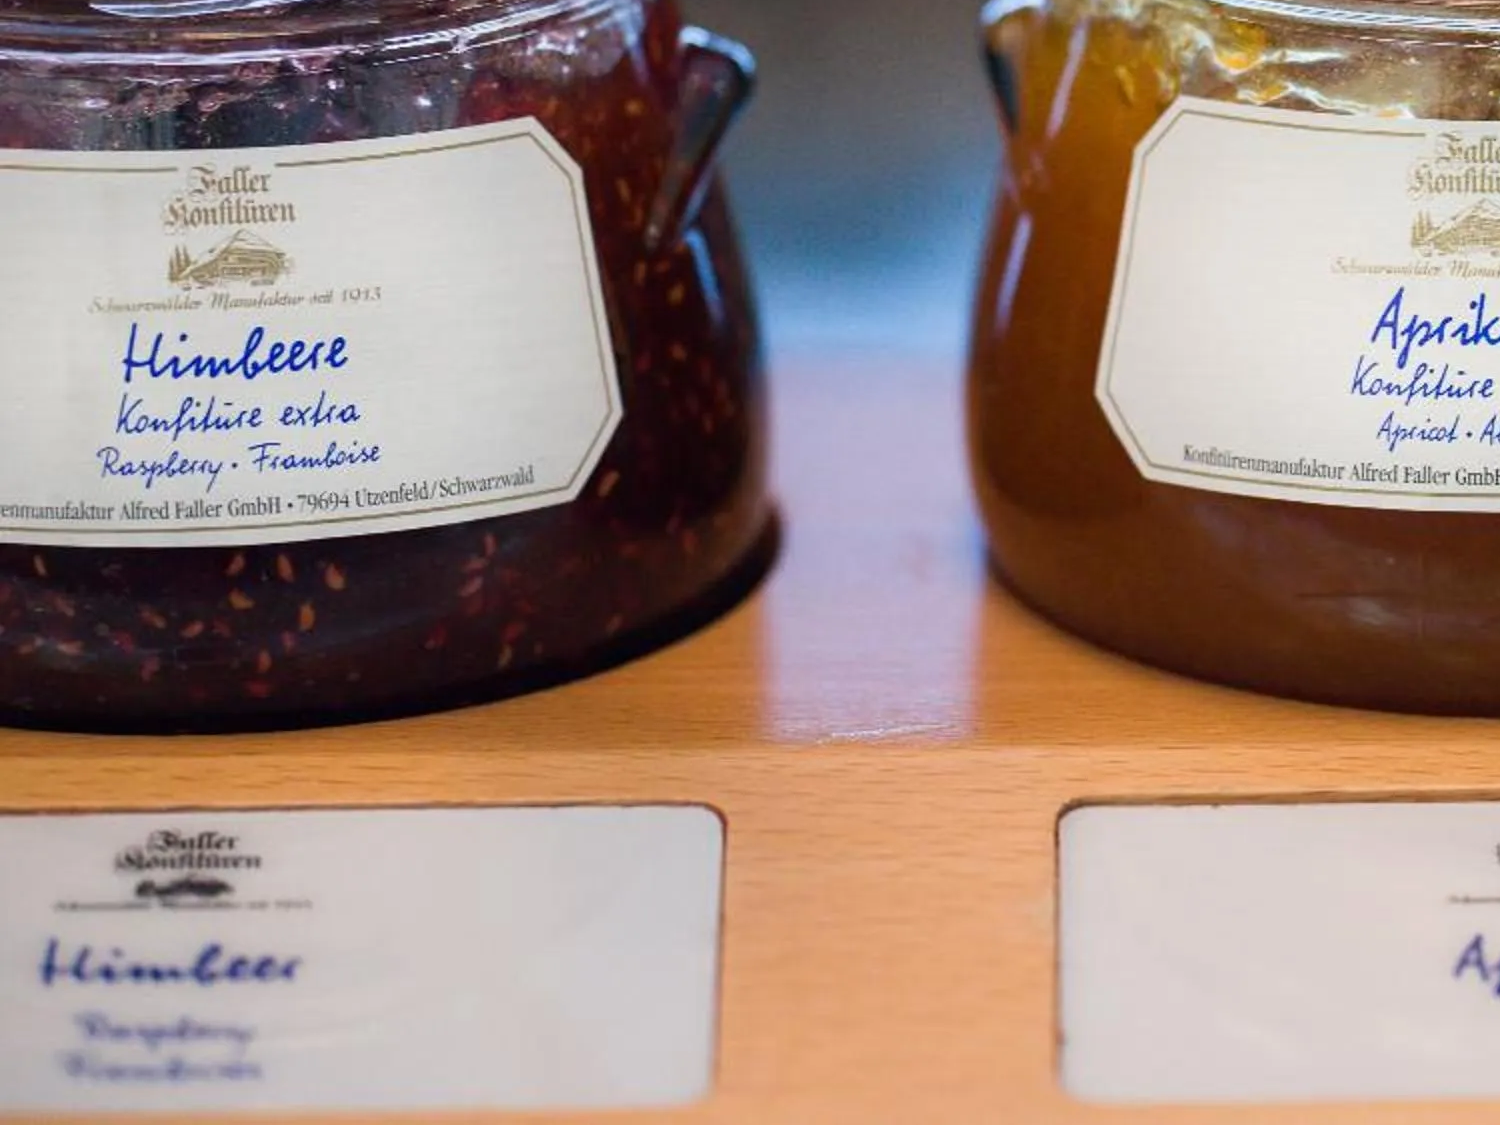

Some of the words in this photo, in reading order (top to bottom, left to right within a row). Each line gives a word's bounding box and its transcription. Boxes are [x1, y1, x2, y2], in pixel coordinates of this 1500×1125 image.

[189, 163, 272, 200] Faller
[162, 194, 297, 234] Konfitüren
[88, 295, 201, 314] Schwarzwälder
[209, 291, 304, 311] Manufaktur
[310, 289, 334, 305] seit
[341, 287, 382, 303] 1913
[122, 322, 349, 383] Himbeere
[1350, 354, 1494, 407] Konfitüre
[116, 392, 262, 442] Konfitüre
[279, 390, 361, 428] extra
[1376, 411, 1460, 452] Apricot
[96, 446, 223, 493] Raspberry
[248, 441, 381, 472] Framboise
[1183, 443, 1345, 481] Konfitürenmanufaktur
[1350, 462, 1398, 484] Alfred
[1403, 464, 1450, 485] Faller
[119, 497, 169, 520] Alfred
[174, 494, 222, 519] Faller
[227, 496, 281, 517] GmbH
[296, 493, 350, 515] 79694
[355, 463, 535, 508] Utzenfeld/Schwarzwald
